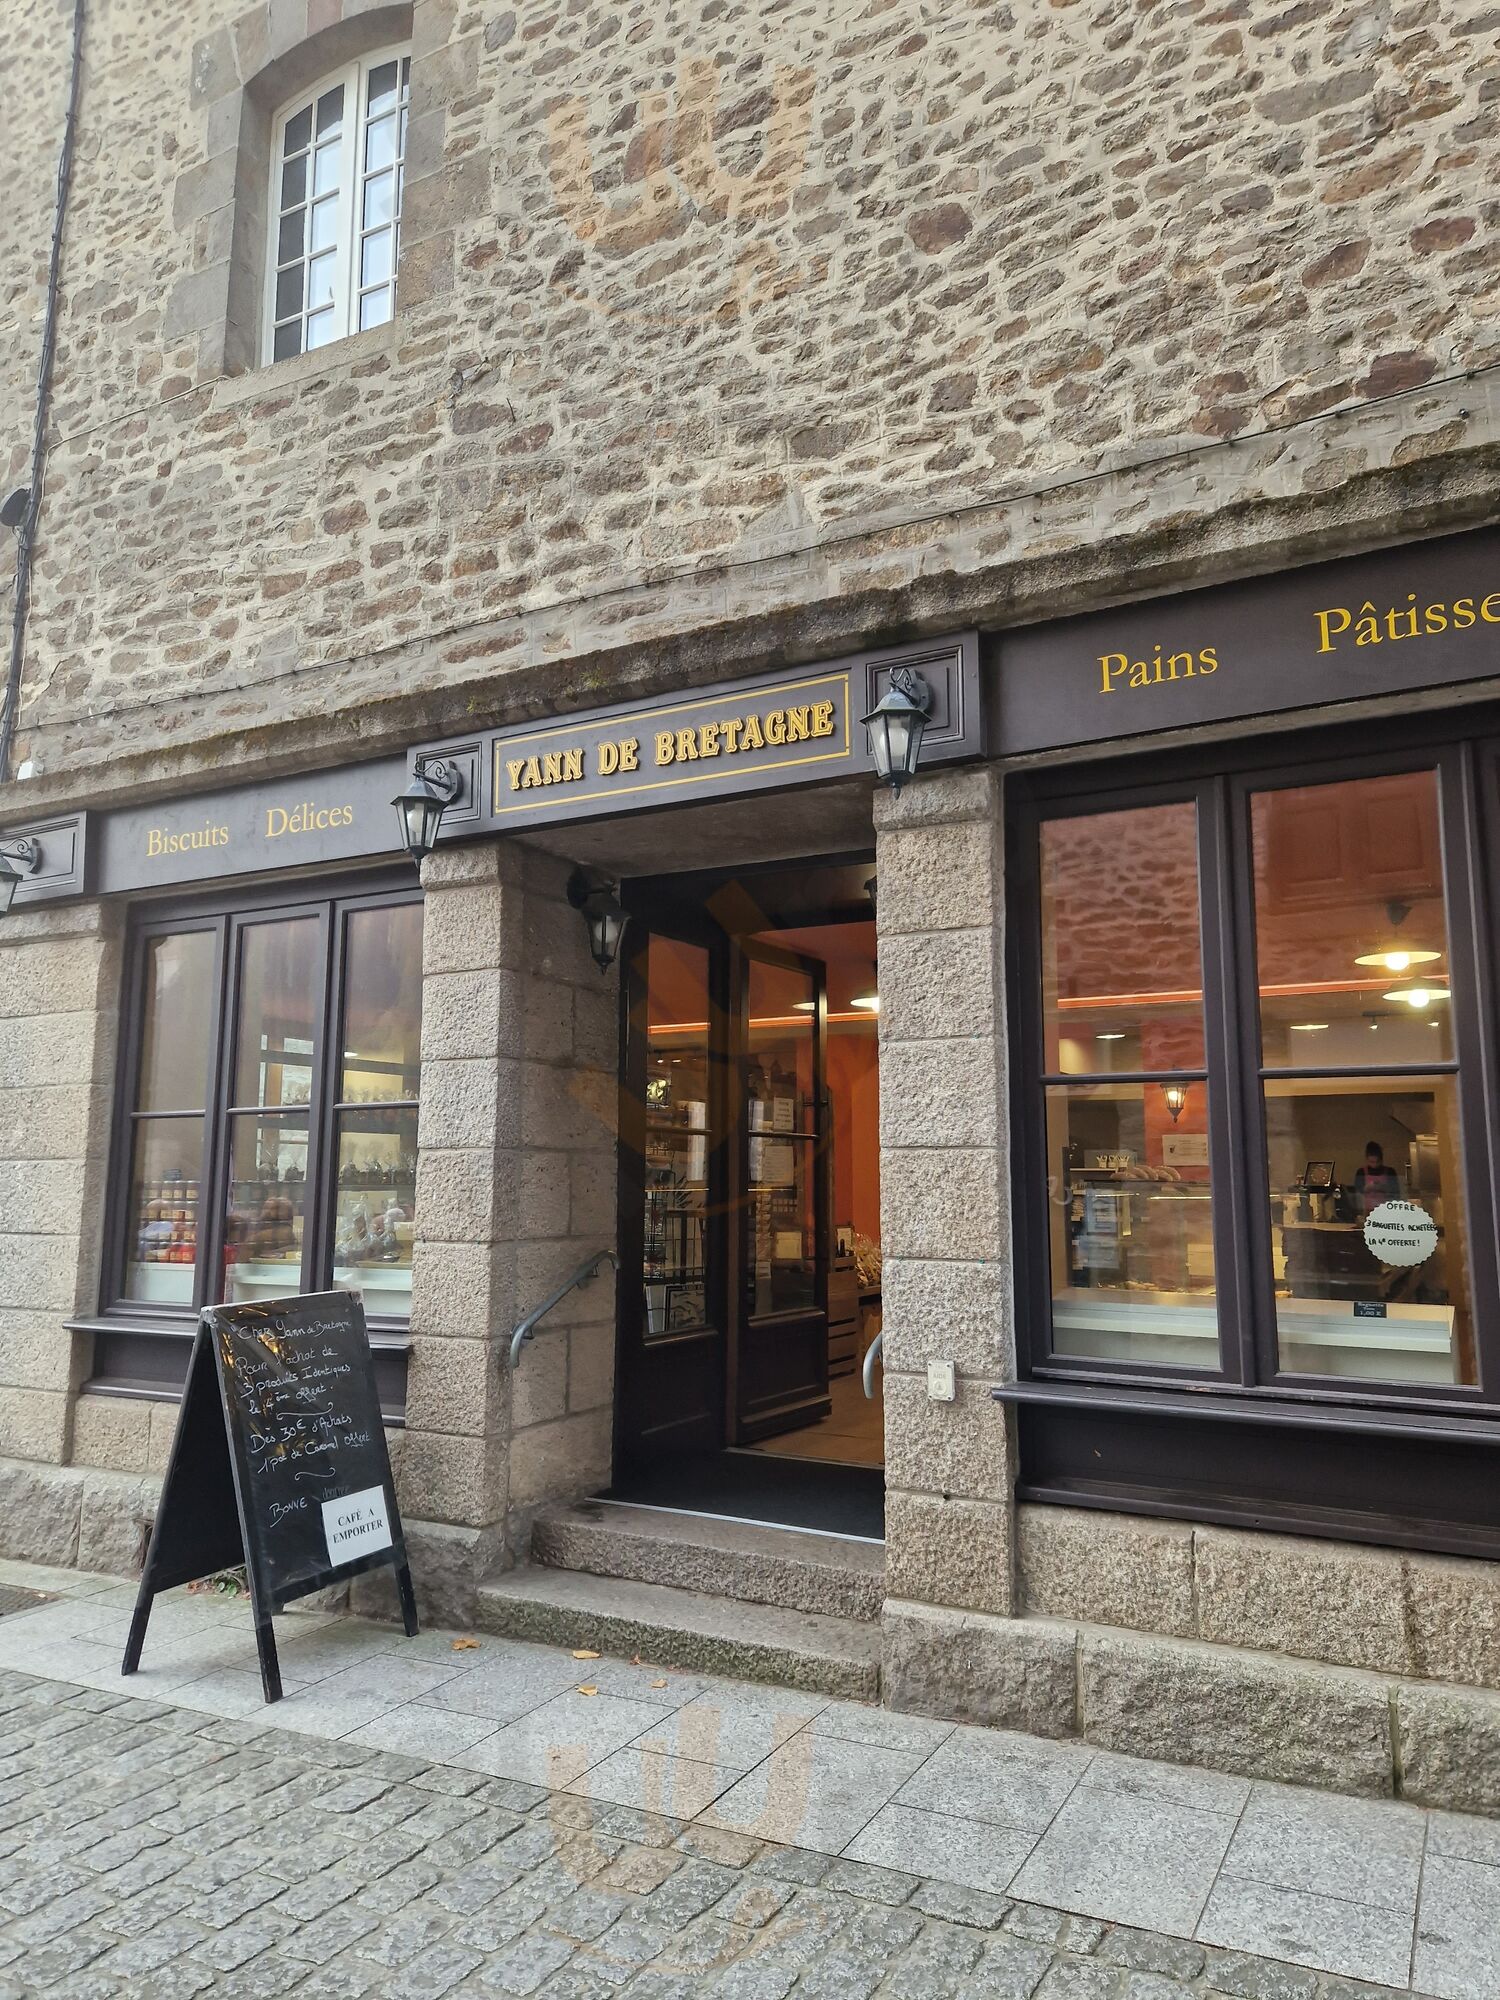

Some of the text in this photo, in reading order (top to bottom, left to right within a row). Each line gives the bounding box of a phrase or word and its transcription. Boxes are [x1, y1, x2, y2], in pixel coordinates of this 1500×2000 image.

[1097, 592, 1500, 694] Pains Pâtisse
[504, 699, 835, 791] YANN DE BRETAGNE
[146, 801, 354, 858] Biscuits Délices
[1386, 1202, 1415, 1211] OFFRE
[1365, 1219, 1371, 1227] 3
[1372, 1222, 1404, 1231] BAGUETTES
[1368, 1238, 1377, 1246] LA
[236, 1325, 276, 1342] Chez
[275, 1319, 307, 1339] Yann
[306, 1325, 316, 1335] de
[234, 1355, 269, 1377] Pour
[322, 1344, 339, 1357] de
[240, 1365, 352, 1399] 3 produits Identiques
[248, 1399, 262, 1415] le
[250, 1426, 277, 1454] Dès
[290, 1448, 303, 1460] de
[368, 1507, 375, 1518] A
[332, 1519, 384, 1544] EMPORTER
